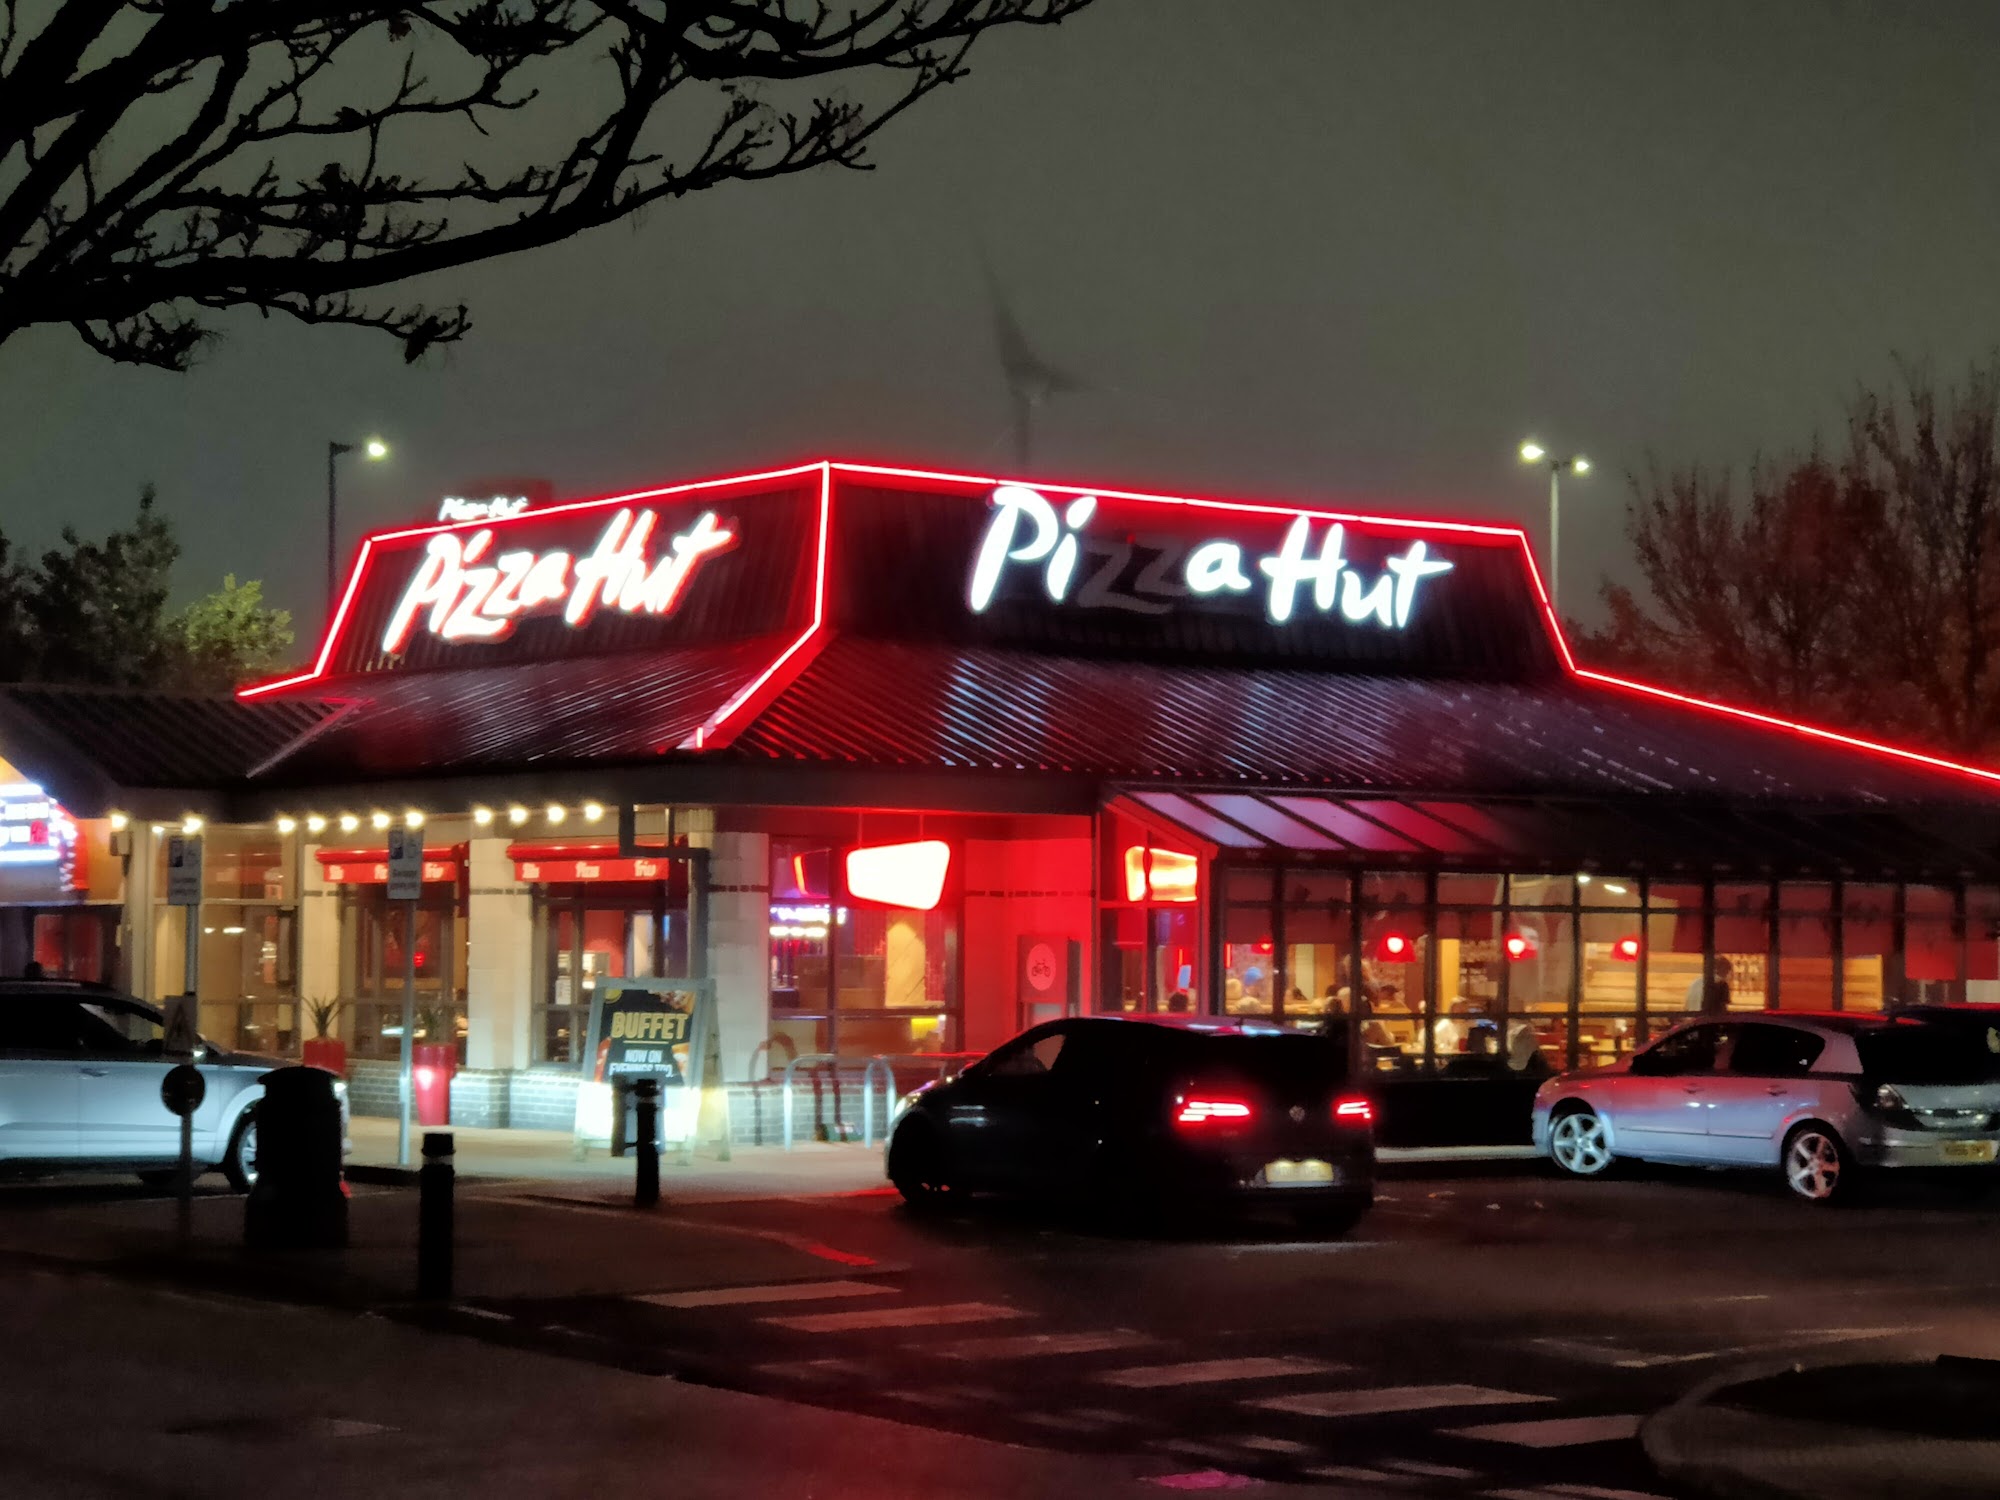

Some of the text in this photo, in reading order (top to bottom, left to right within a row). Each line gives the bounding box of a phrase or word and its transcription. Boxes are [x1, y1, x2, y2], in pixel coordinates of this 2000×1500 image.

[382, 508, 736, 653] Pizza Hut
[968, 485, 1454, 628] Pizza Hut
[612, 1012, 689, 1040] BUFFET
